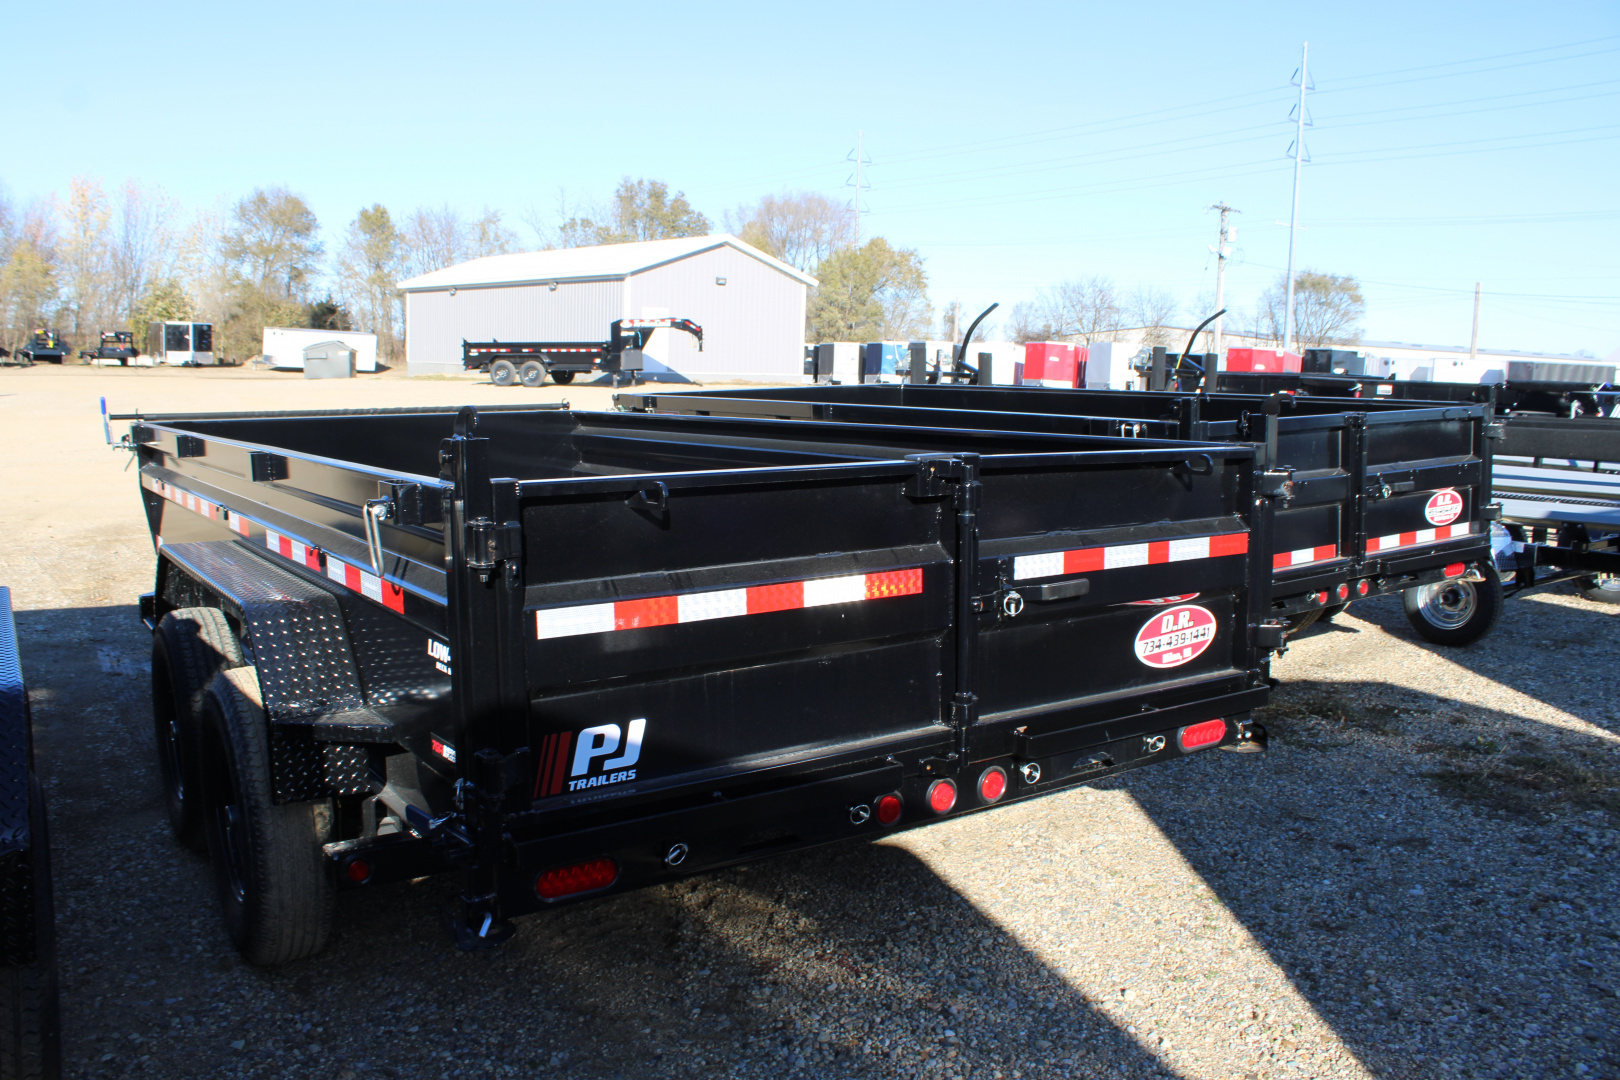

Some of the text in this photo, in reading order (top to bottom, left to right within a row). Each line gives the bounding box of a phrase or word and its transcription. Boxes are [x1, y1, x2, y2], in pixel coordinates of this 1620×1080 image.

[1161, 611, 1194, 635] D.R.
[1143, 627, 1210, 654] 734-439-1441
[571, 718, 647, 777] PJ
[568, 769, 637, 792] TRAILERS
